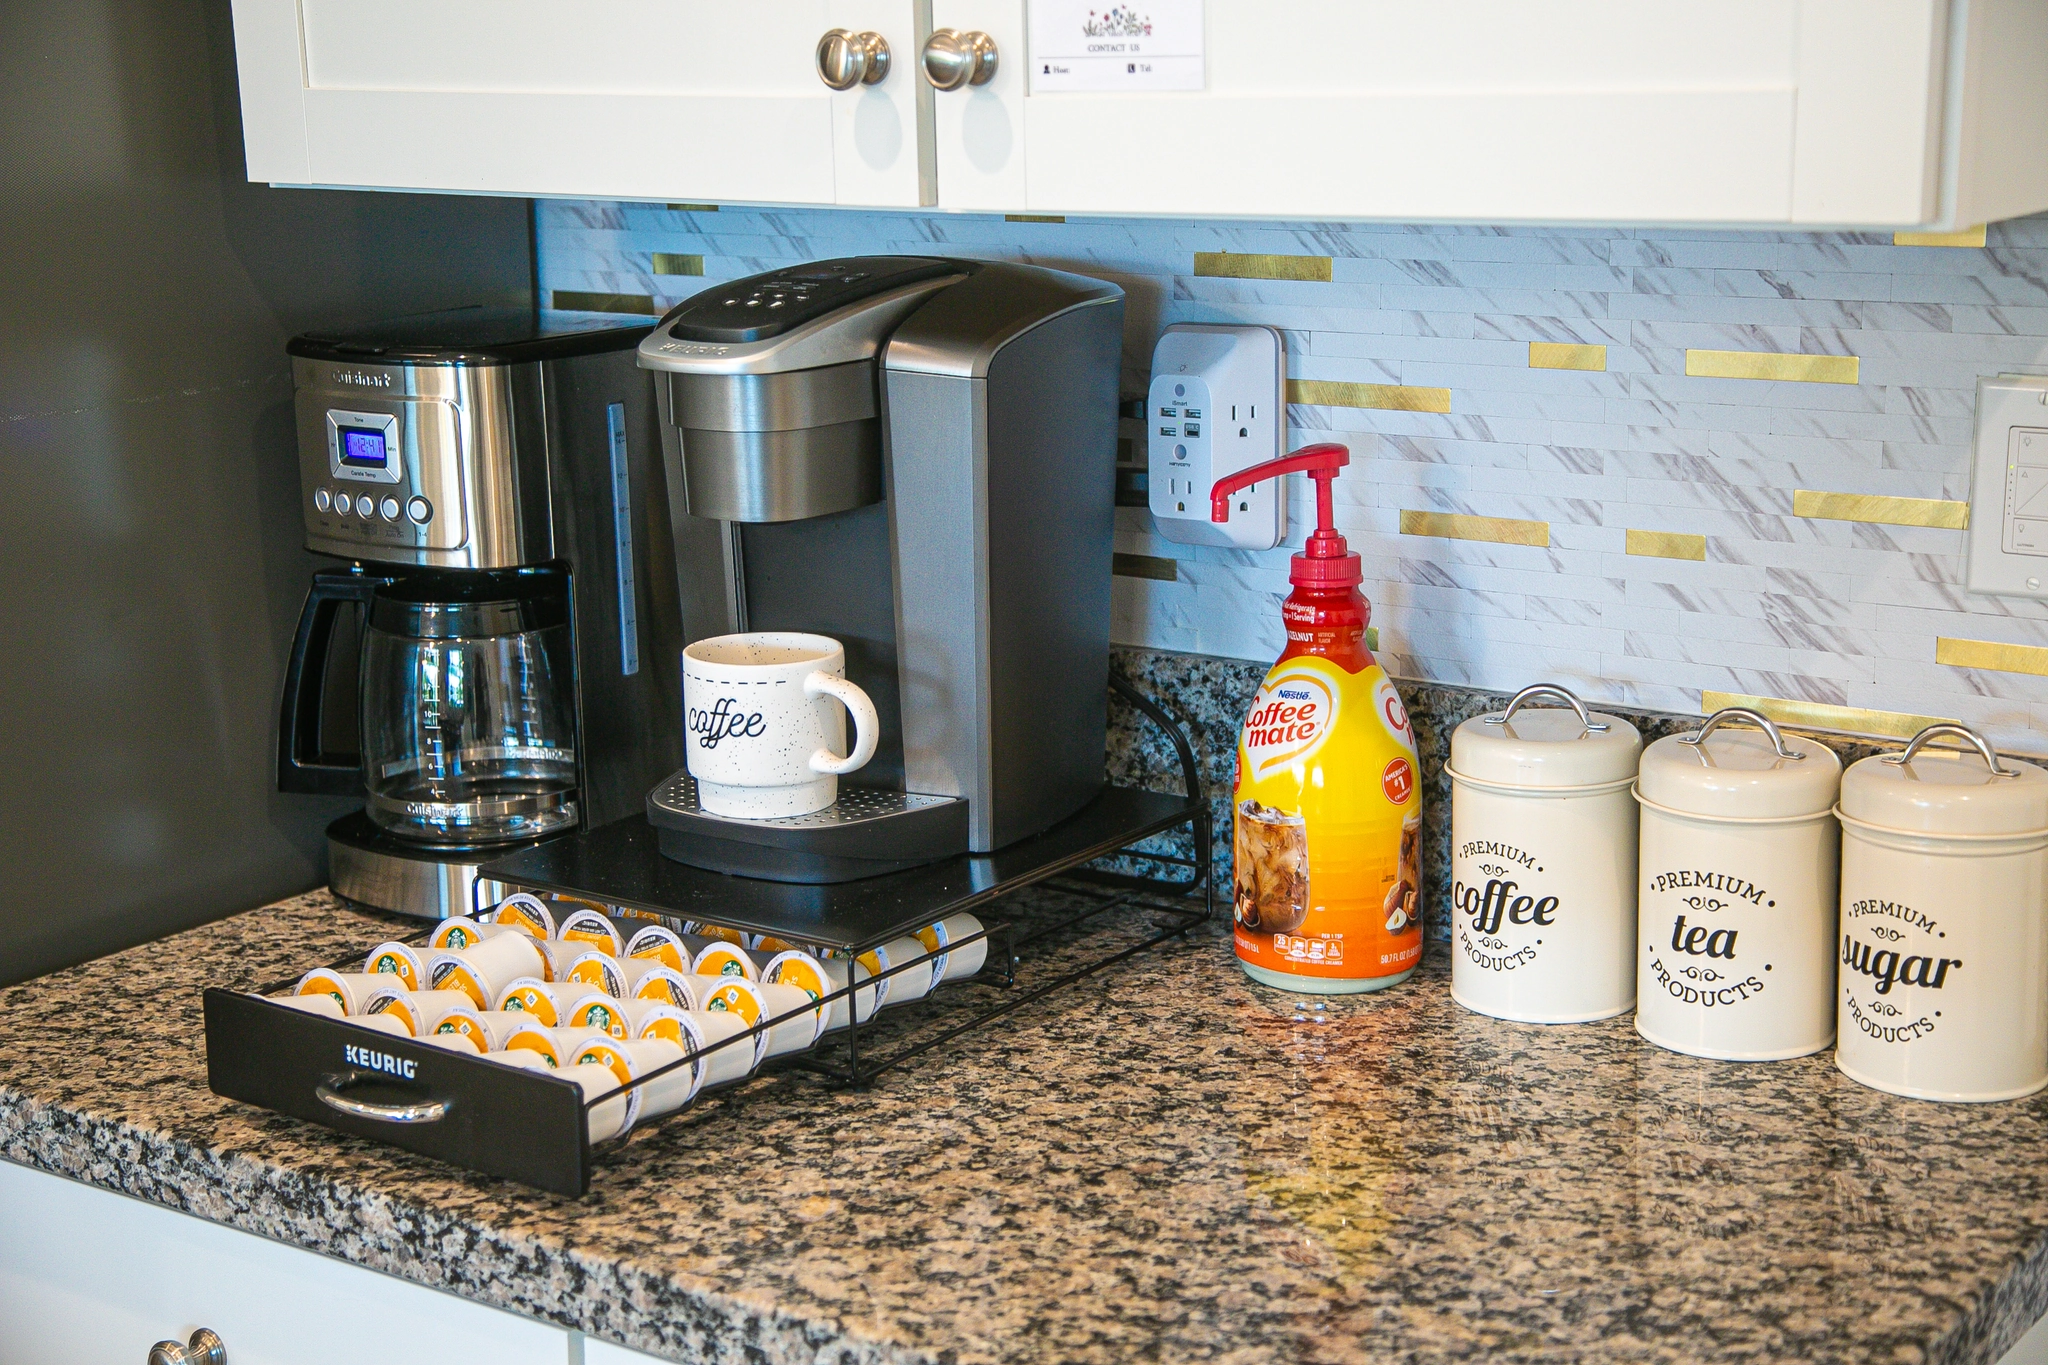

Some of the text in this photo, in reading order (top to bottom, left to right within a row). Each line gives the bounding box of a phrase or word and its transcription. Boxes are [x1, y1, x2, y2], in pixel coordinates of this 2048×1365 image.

[1087, 44, 1126, 52] CONTACT
[1294, 612, 1315, 624] Serving
[1288, 630, 1314, 642] AZELNUT
[1278, 689, 1310, 700] Nestlé
[688, 698, 766, 750] coffee
[1245, 695, 1317, 729] Coffee
[1248, 721, 1315, 748] mate
[1394, 775, 1405, 790] #1
[1463, 841, 1536, 870] PREMIUM
[1656, 871, 1766, 906] PREMIUM
[1454, 879, 1560, 935] coffee
[1853, 900, 1937, 934] PREMIUM
[1277, 935, 1286, 946] 25
[1460, 931, 1536, 972] PRODUCTS
[1671, 915, 1738, 960] tea
[1842, 934, 1963, 995] sugar
[1651, 958, 1764, 1007] PRODUCTS
[1847, 996, 1935, 1043] PRODUCTS
[345, 1044, 415, 1079] KEURIG
